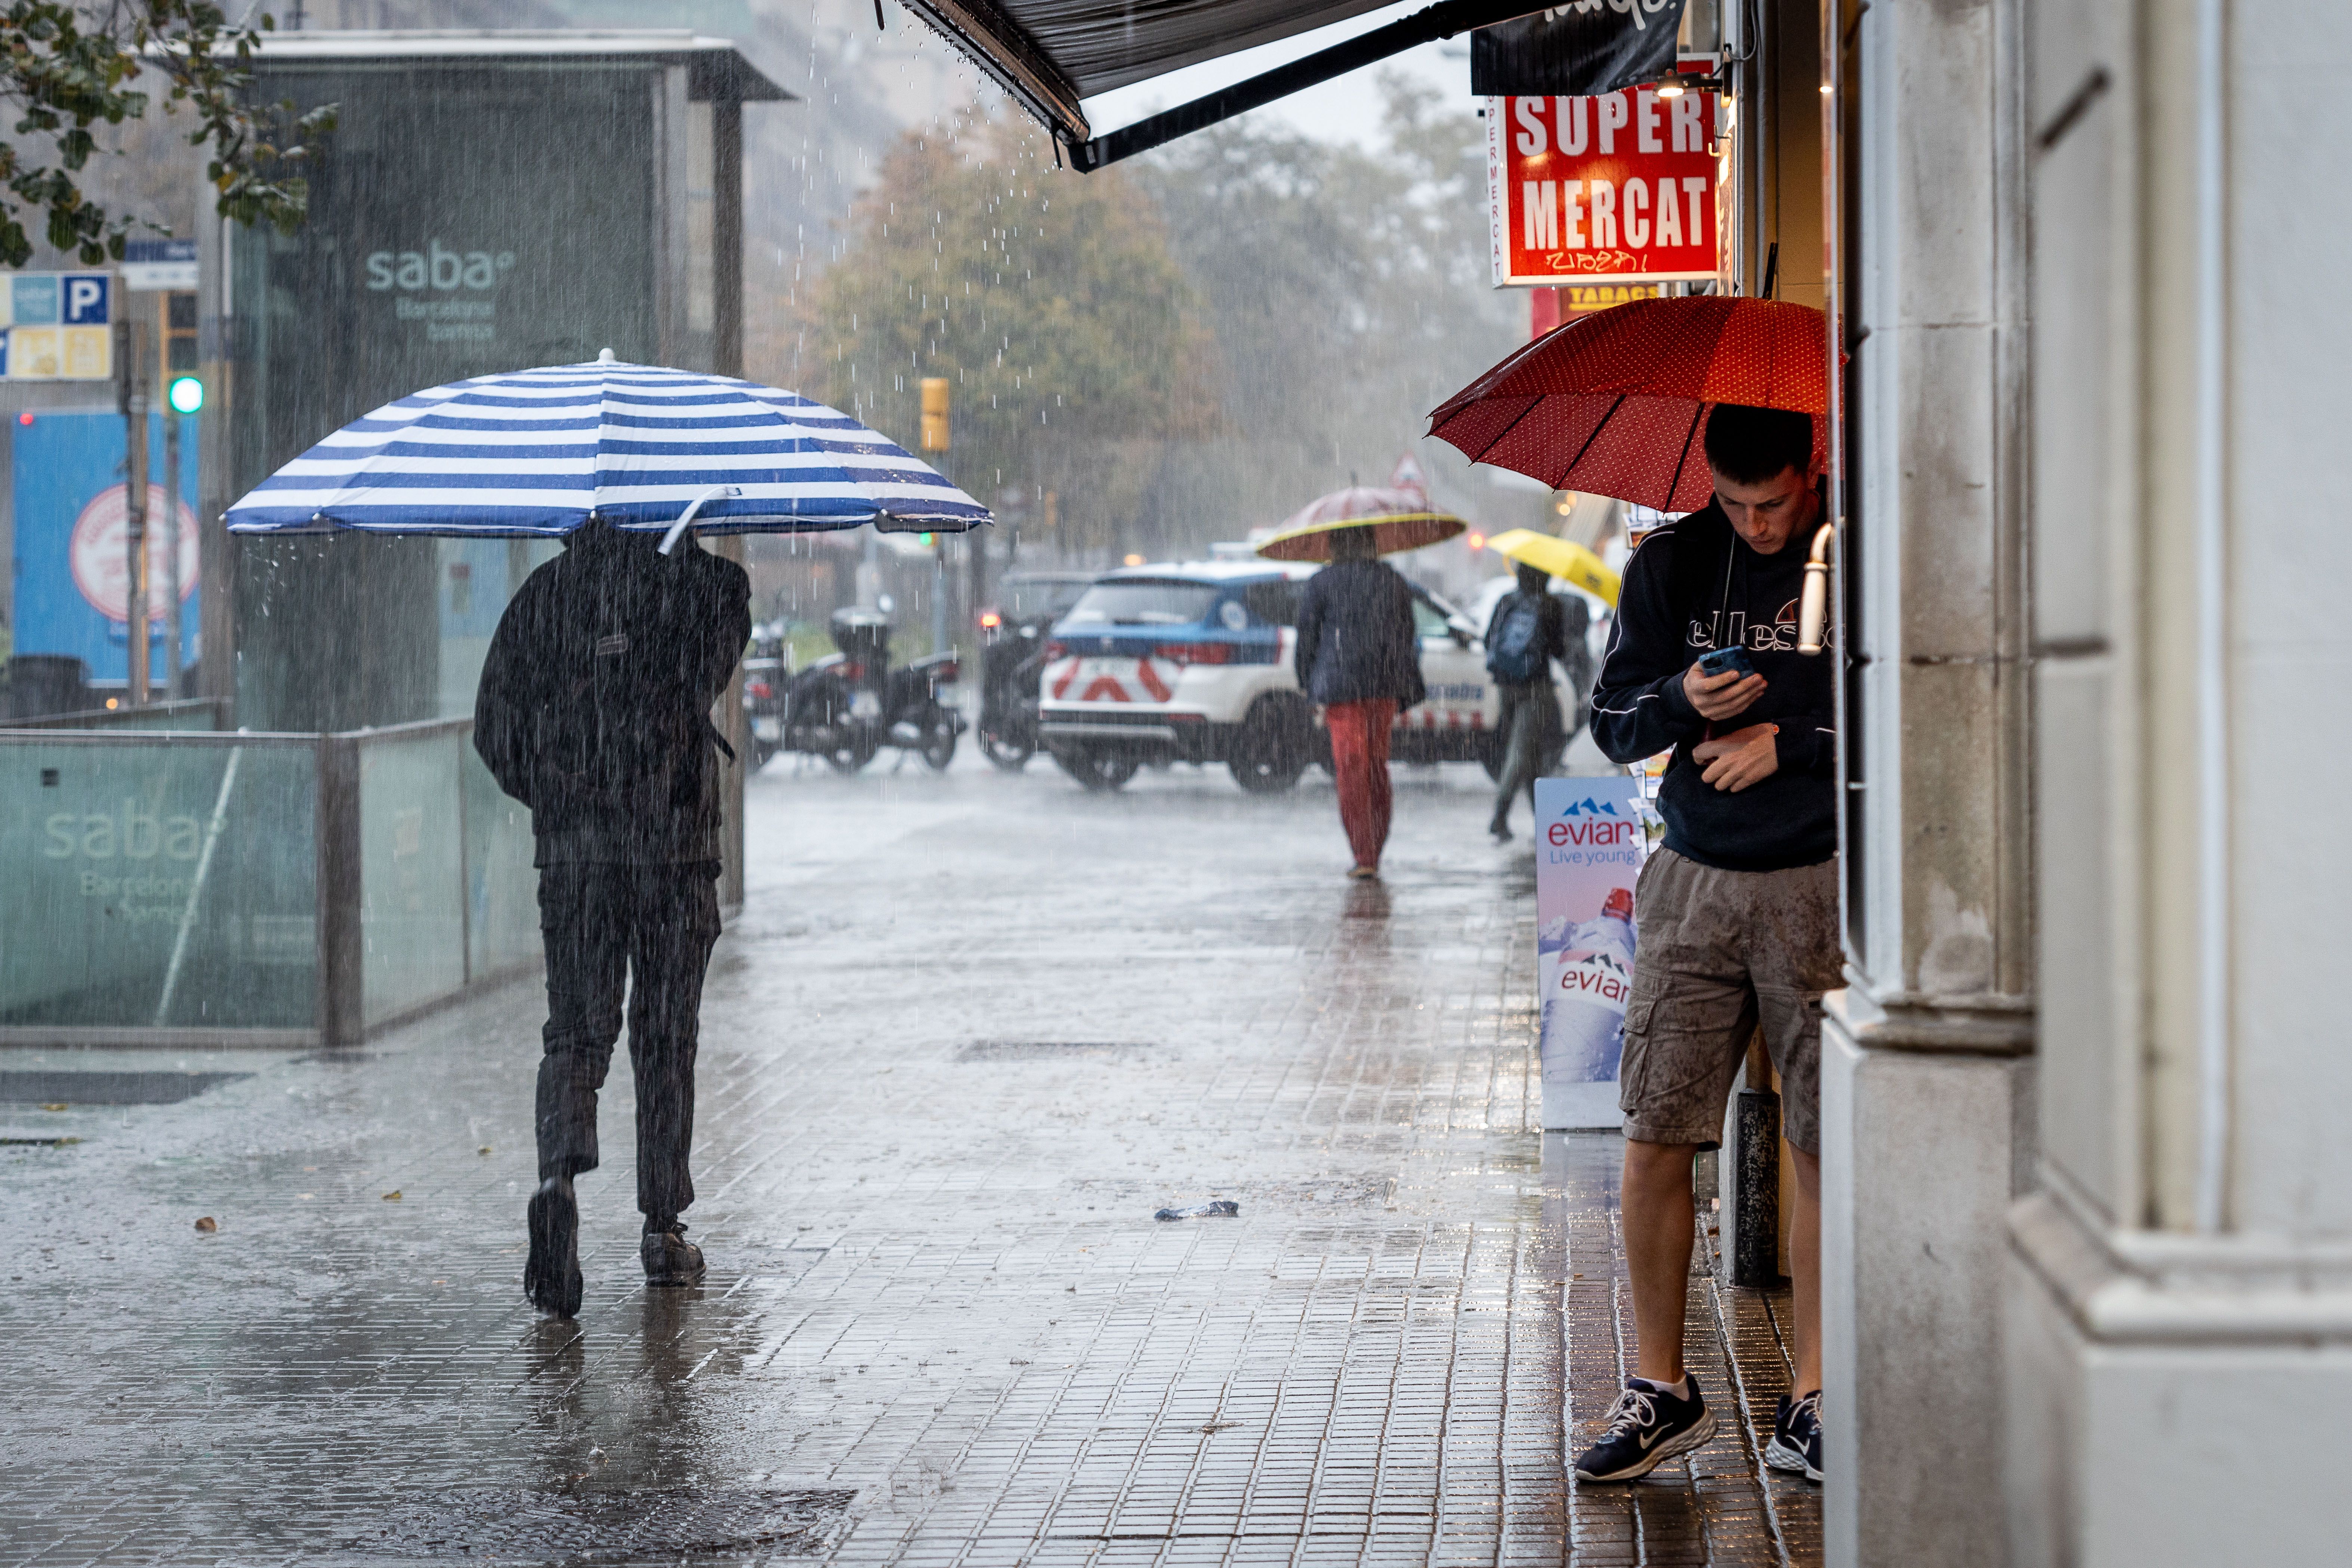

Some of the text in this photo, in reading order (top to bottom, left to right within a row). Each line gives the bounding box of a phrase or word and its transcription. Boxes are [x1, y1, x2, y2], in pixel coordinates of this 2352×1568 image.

[1515, 89, 1703, 156] SUPER
[1524, 177, 1707, 250] MERCAT
[365, 237, 495, 290] saba
[70, 280, 101, 321] P
[44, 797, 200, 859] saba
[1548, 816, 1634, 846] evian
[1550, 850, 1636, 867] Live young
